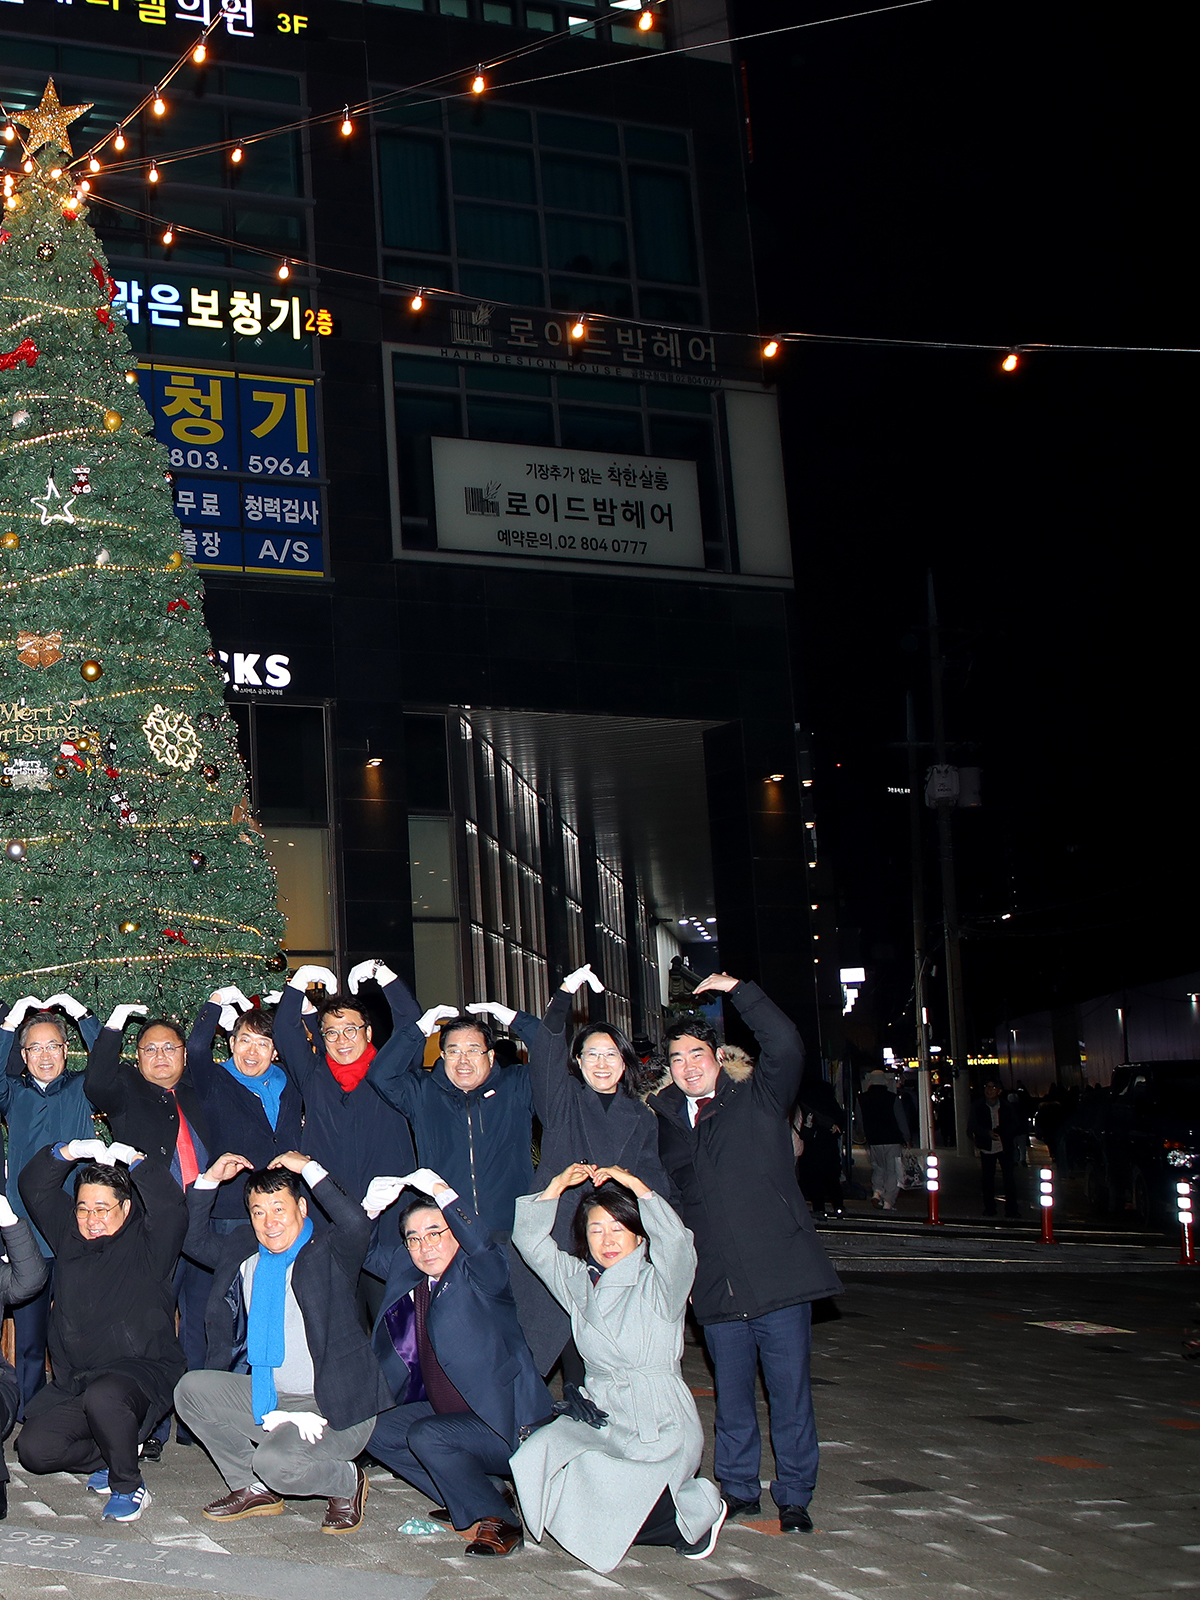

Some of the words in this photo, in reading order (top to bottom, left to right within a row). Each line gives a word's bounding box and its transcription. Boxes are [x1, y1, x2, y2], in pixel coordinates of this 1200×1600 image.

[277, 13, 308, 34] 3F
[305, 309, 334, 336] 2층
[507, 316, 717, 372] 로이드밤헤어
[440, 348, 482, 361] HAIR
[493, 354, 557, 370] DESIGN
[567, 361, 623, 377] HOUSE
[248, 455, 311, 478] 5964
[526, 463, 575, 483] 기장추가
[579, 467, 603, 485] 없는
[176, 490, 221, 517] 무료
[245, 495, 319, 526] 청력검사
[505, 491, 674, 532] 로이드밤헤어
[258, 539, 310, 563] A/S
[581, 536, 609, 552] 804
[611, 539, 648, 556] 0777
